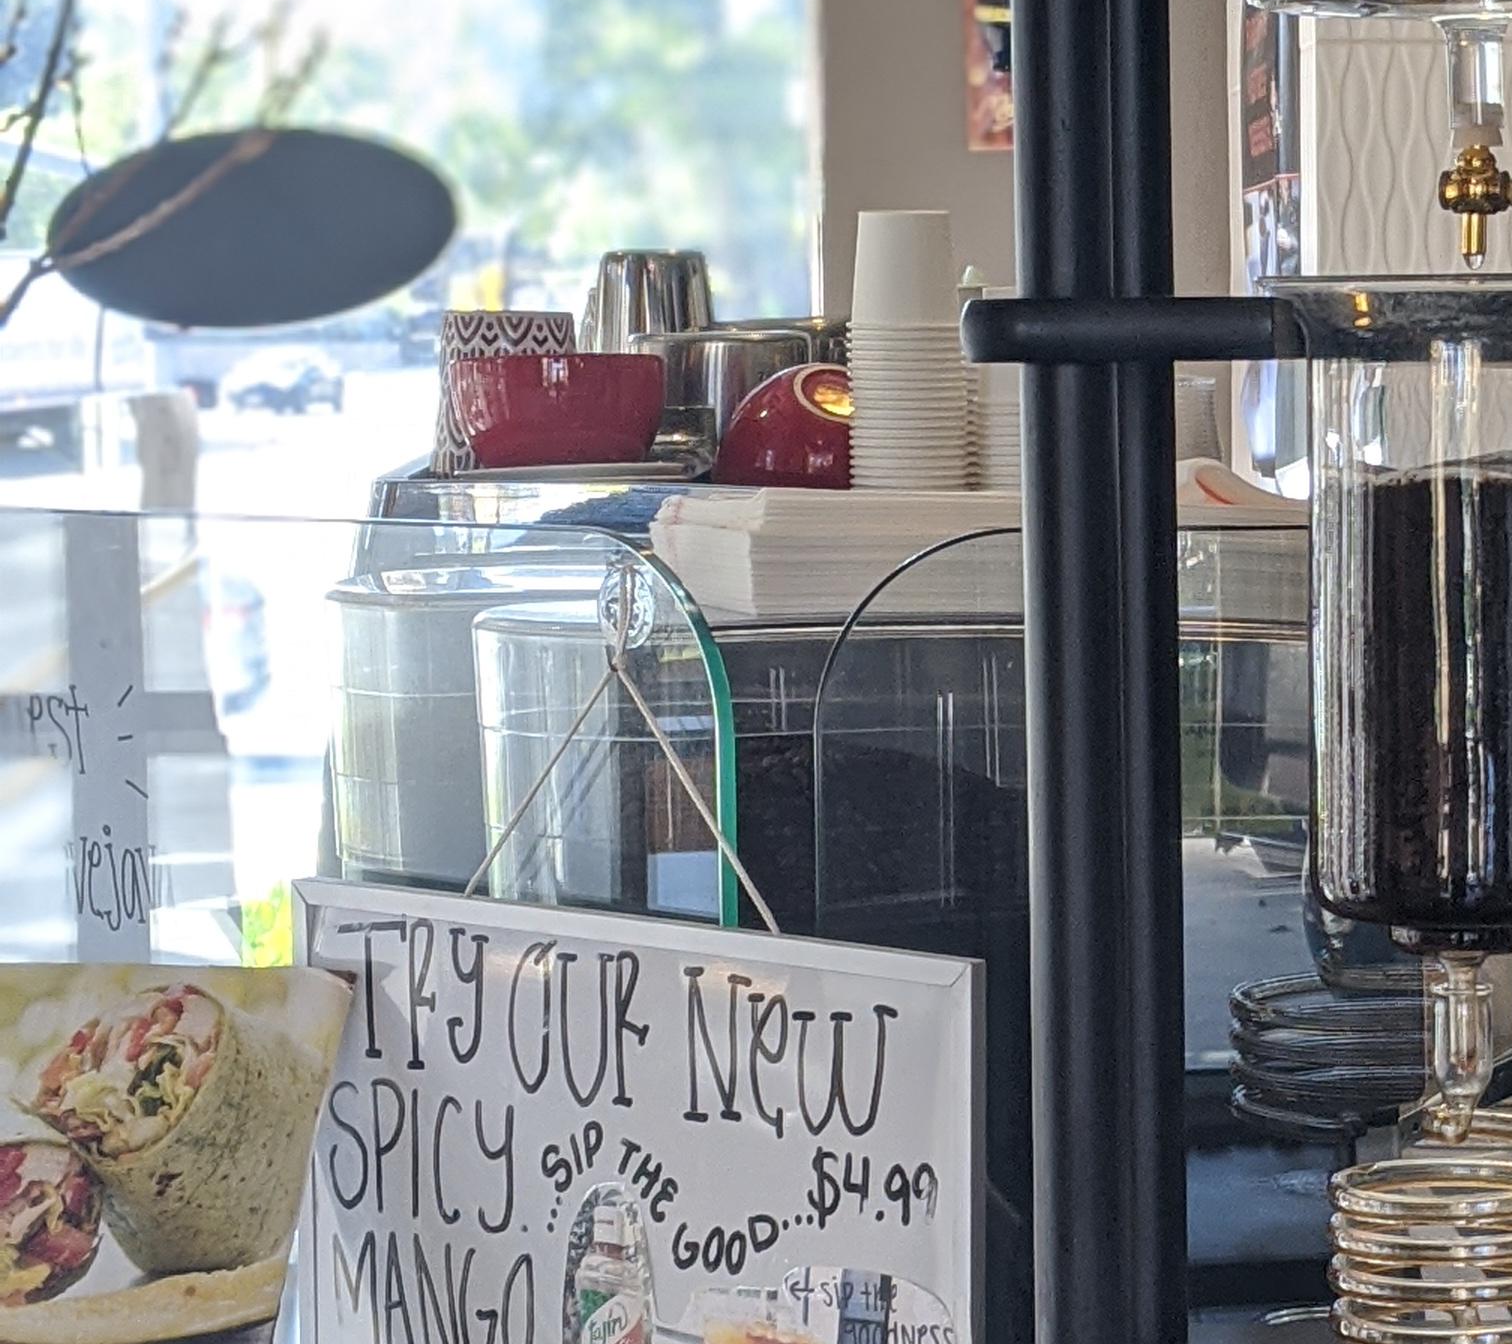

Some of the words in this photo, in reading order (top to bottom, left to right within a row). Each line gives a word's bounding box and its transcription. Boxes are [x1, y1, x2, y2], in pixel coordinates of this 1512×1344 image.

[336, 917, 492, 1072] TRY
[508, 938, 650, 1109] OUR
[616, 1136, 678, 1223] THE
[806, 1145, 940, 1230] $4.99
